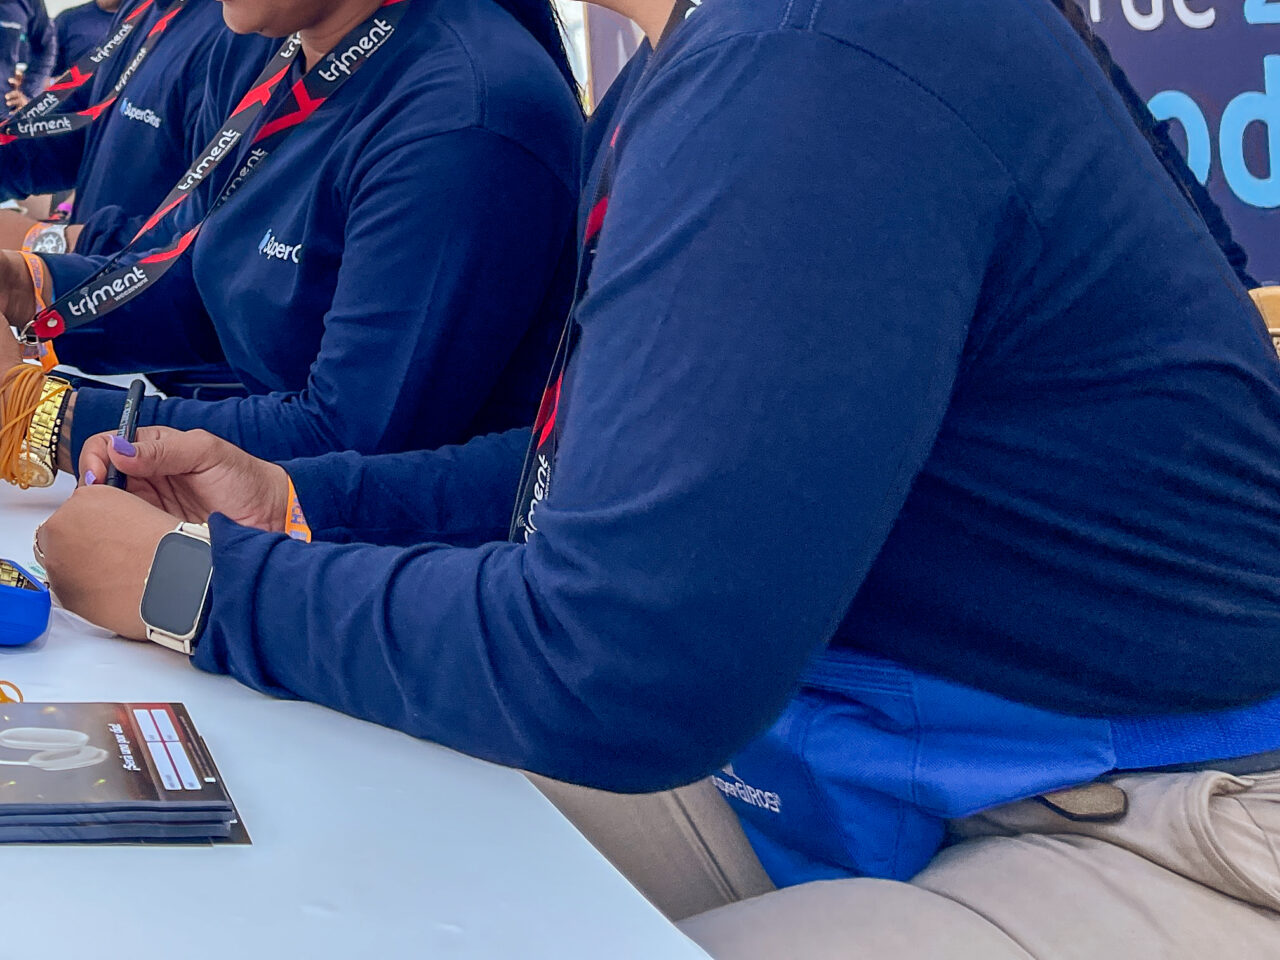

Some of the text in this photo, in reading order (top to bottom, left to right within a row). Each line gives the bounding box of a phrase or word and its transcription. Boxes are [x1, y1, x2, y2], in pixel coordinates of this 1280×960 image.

[90, 23, 133, 63] triment
[318, 19, 392, 82] triment
[17, 117, 72, 137] triment
[177, 129, 238, 191] triment
[68, 266, 146, 316] triment
